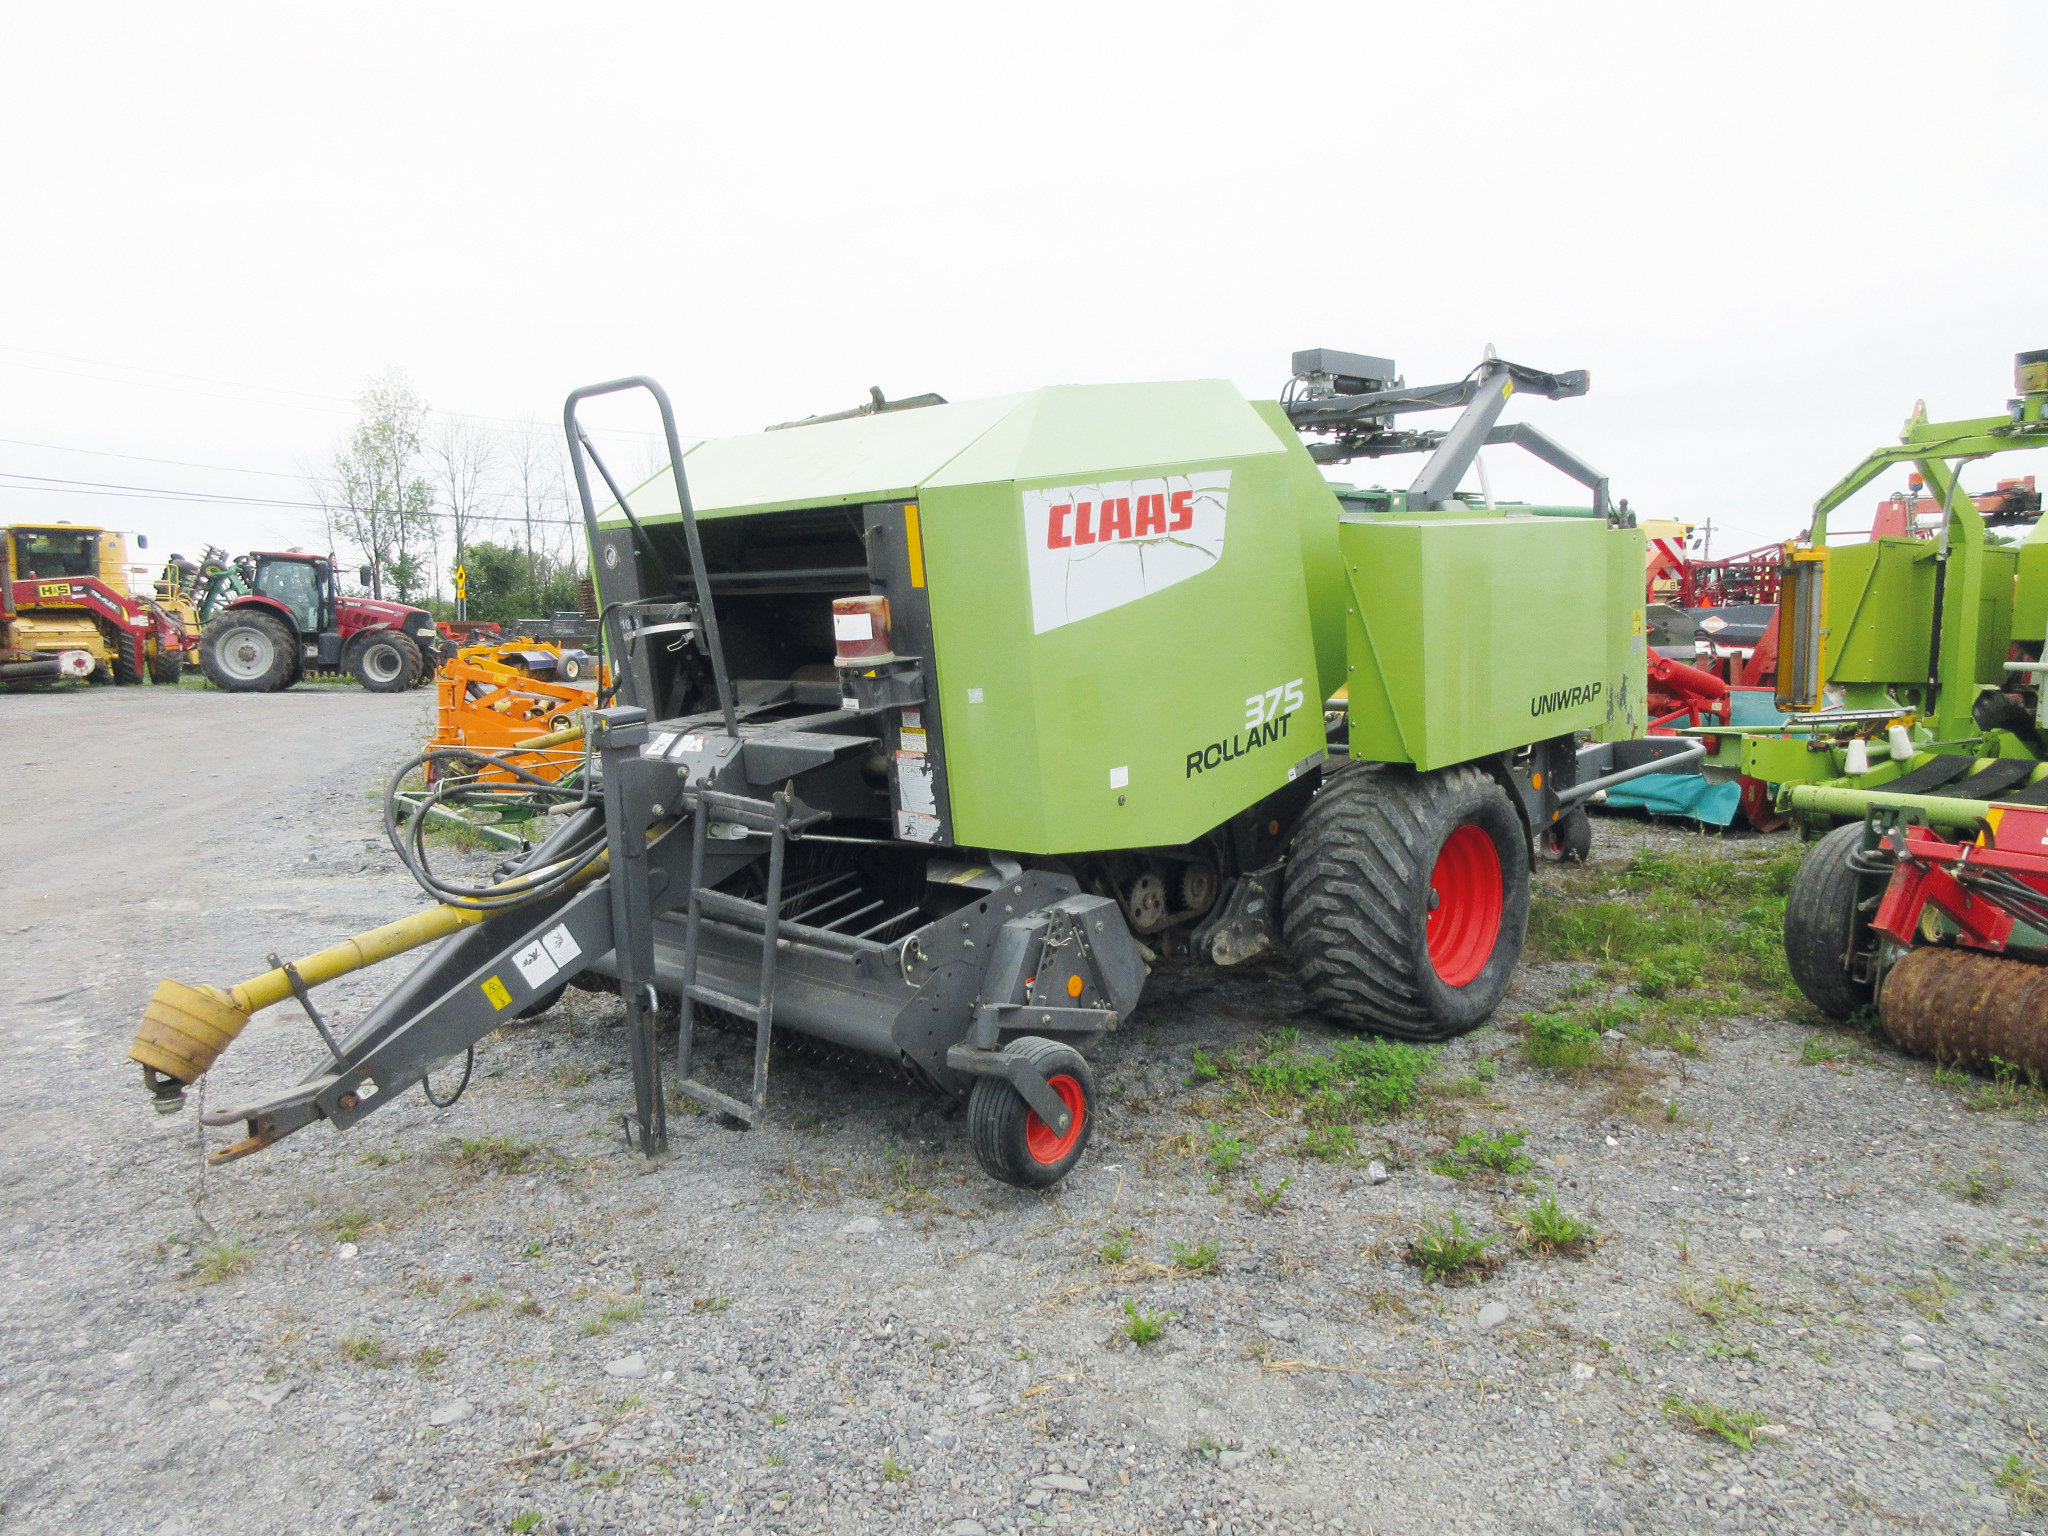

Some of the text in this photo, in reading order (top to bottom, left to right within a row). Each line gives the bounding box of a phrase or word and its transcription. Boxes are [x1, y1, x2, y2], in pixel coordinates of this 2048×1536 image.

[1047, 490, 1193, 549] CLAAS
[1701, 620, 1724, 628] KUHN
[1245, 677, 1304, 730] 375
[1531, 681, 1602, 718] UNIWRAP
[1186, 712, 1292, 779] ROLLANT
